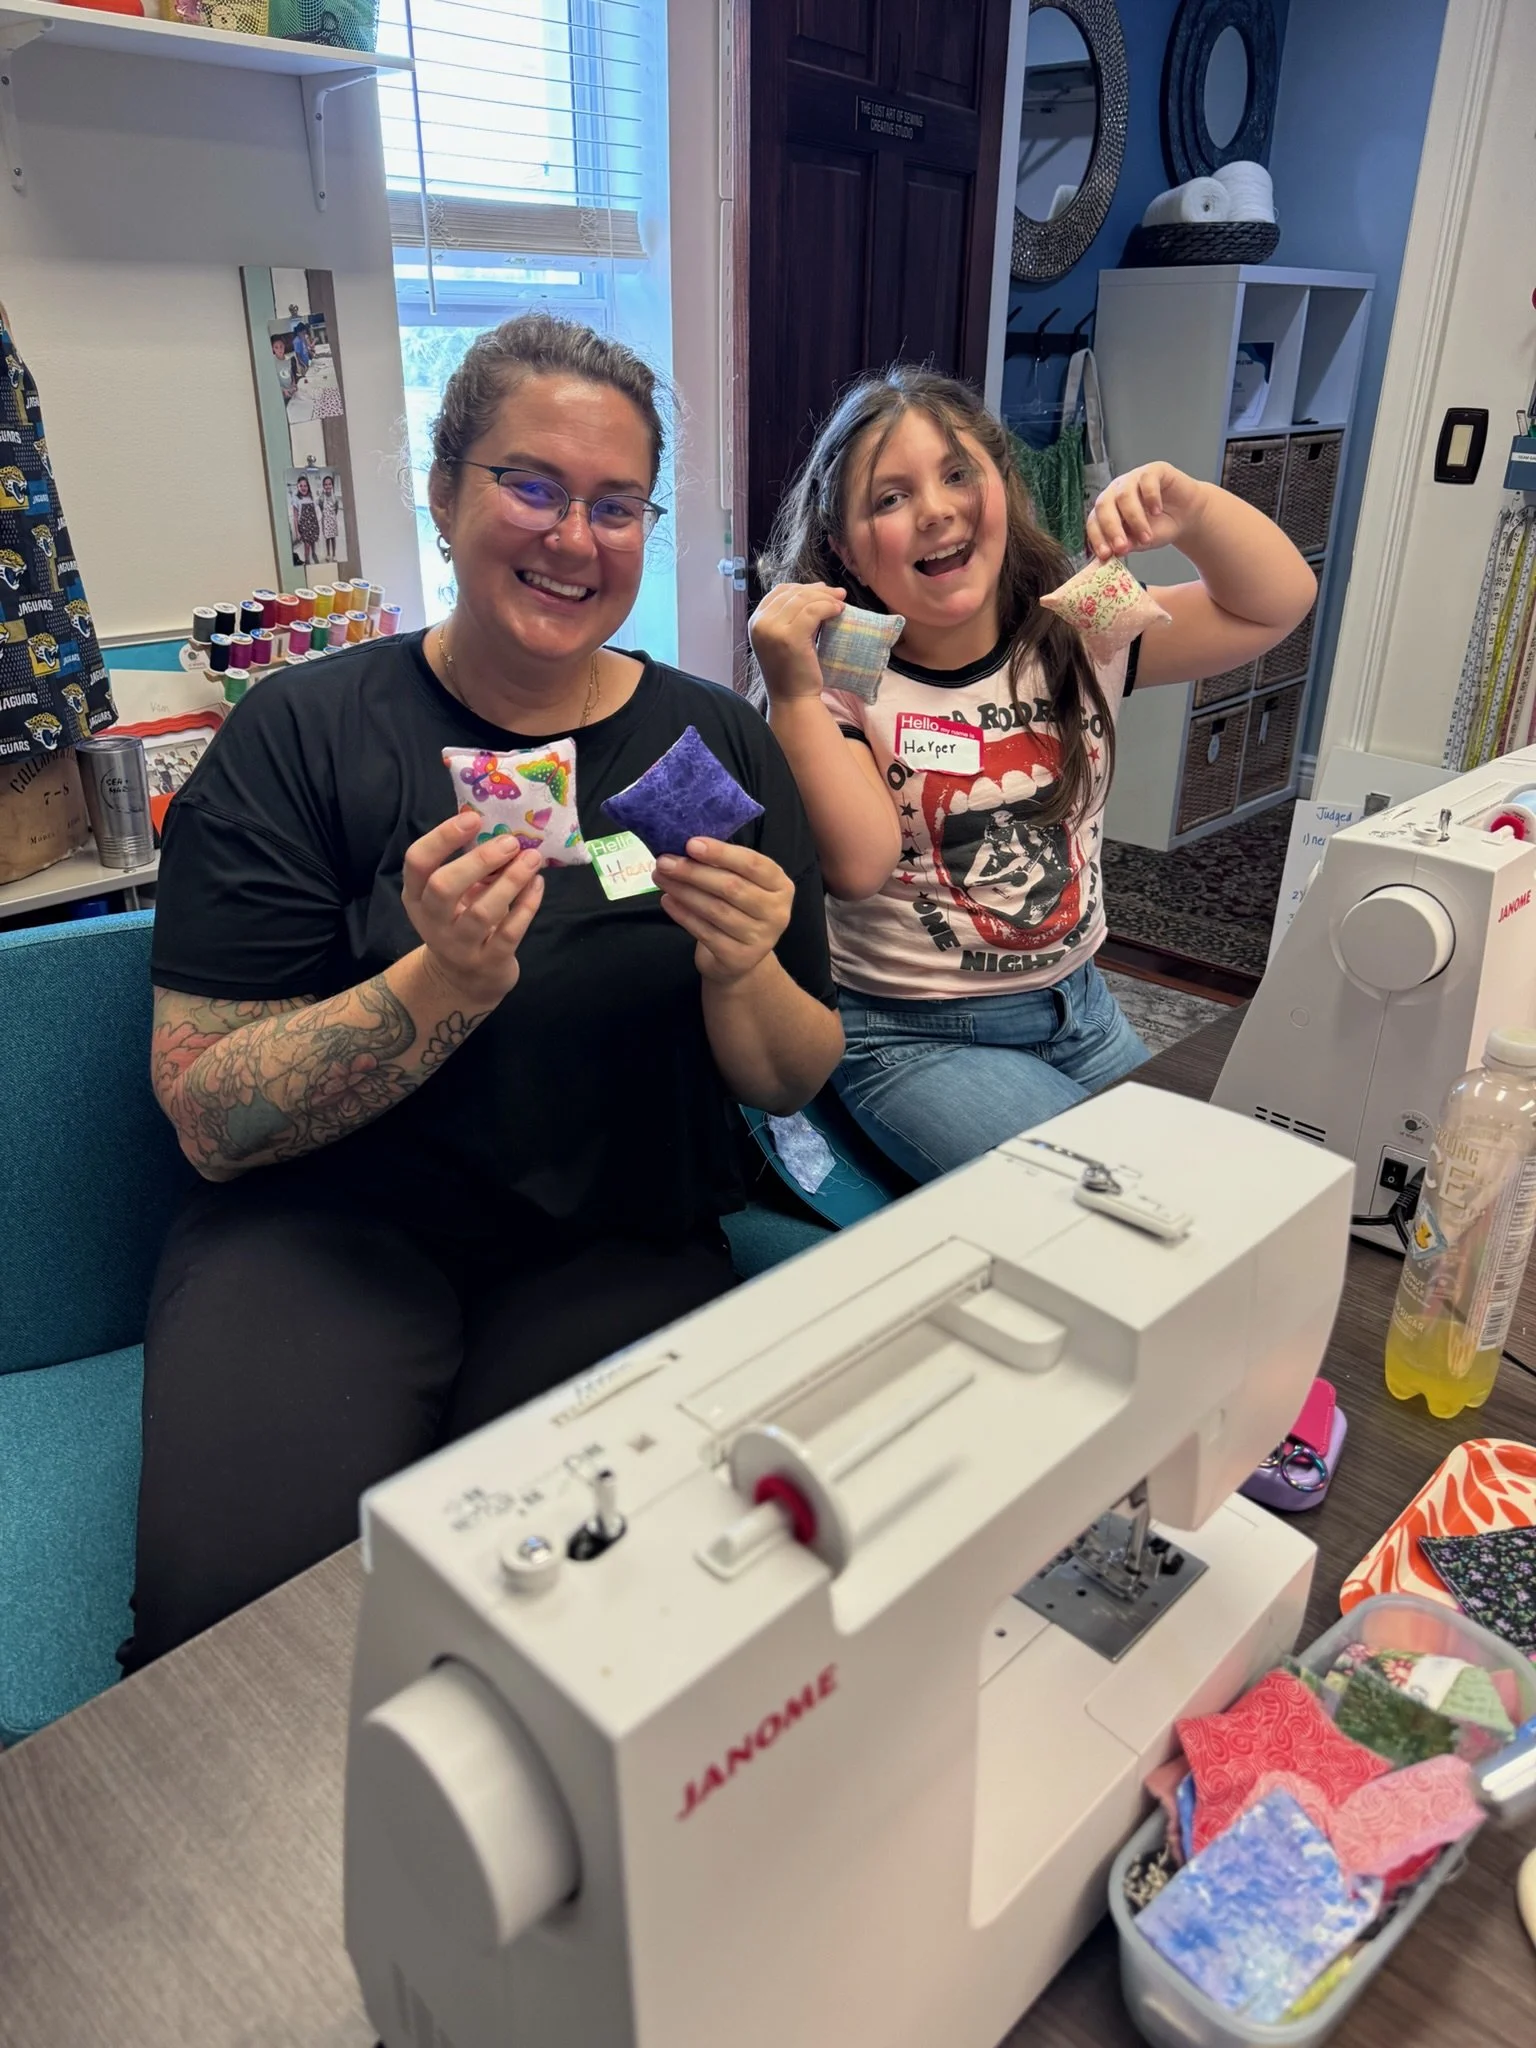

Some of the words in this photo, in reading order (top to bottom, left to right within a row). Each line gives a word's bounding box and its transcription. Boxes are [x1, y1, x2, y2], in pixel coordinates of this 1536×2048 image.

[860, 100, 871, 115] THE
[18, 599, 54, 617] JAGUARS
[88, 711, 112, 729] JAGUARS
[901, 716, 940, 732] Hello
[977, 698, 1104, 739] RODRGO
[0, 740, 30, 756] GUARS
[904, 740, 956, 759] Harper
[1316, 807, 1352, 828] Judged
[591, 836, 636, 855] Hello
[1498, 889, 1532, 923] JANOME
[912, 901, 962, 953] ONE
[960, 950, 1066, 973] NIGHT
[676, 1663, 839, 1822] JANOME
